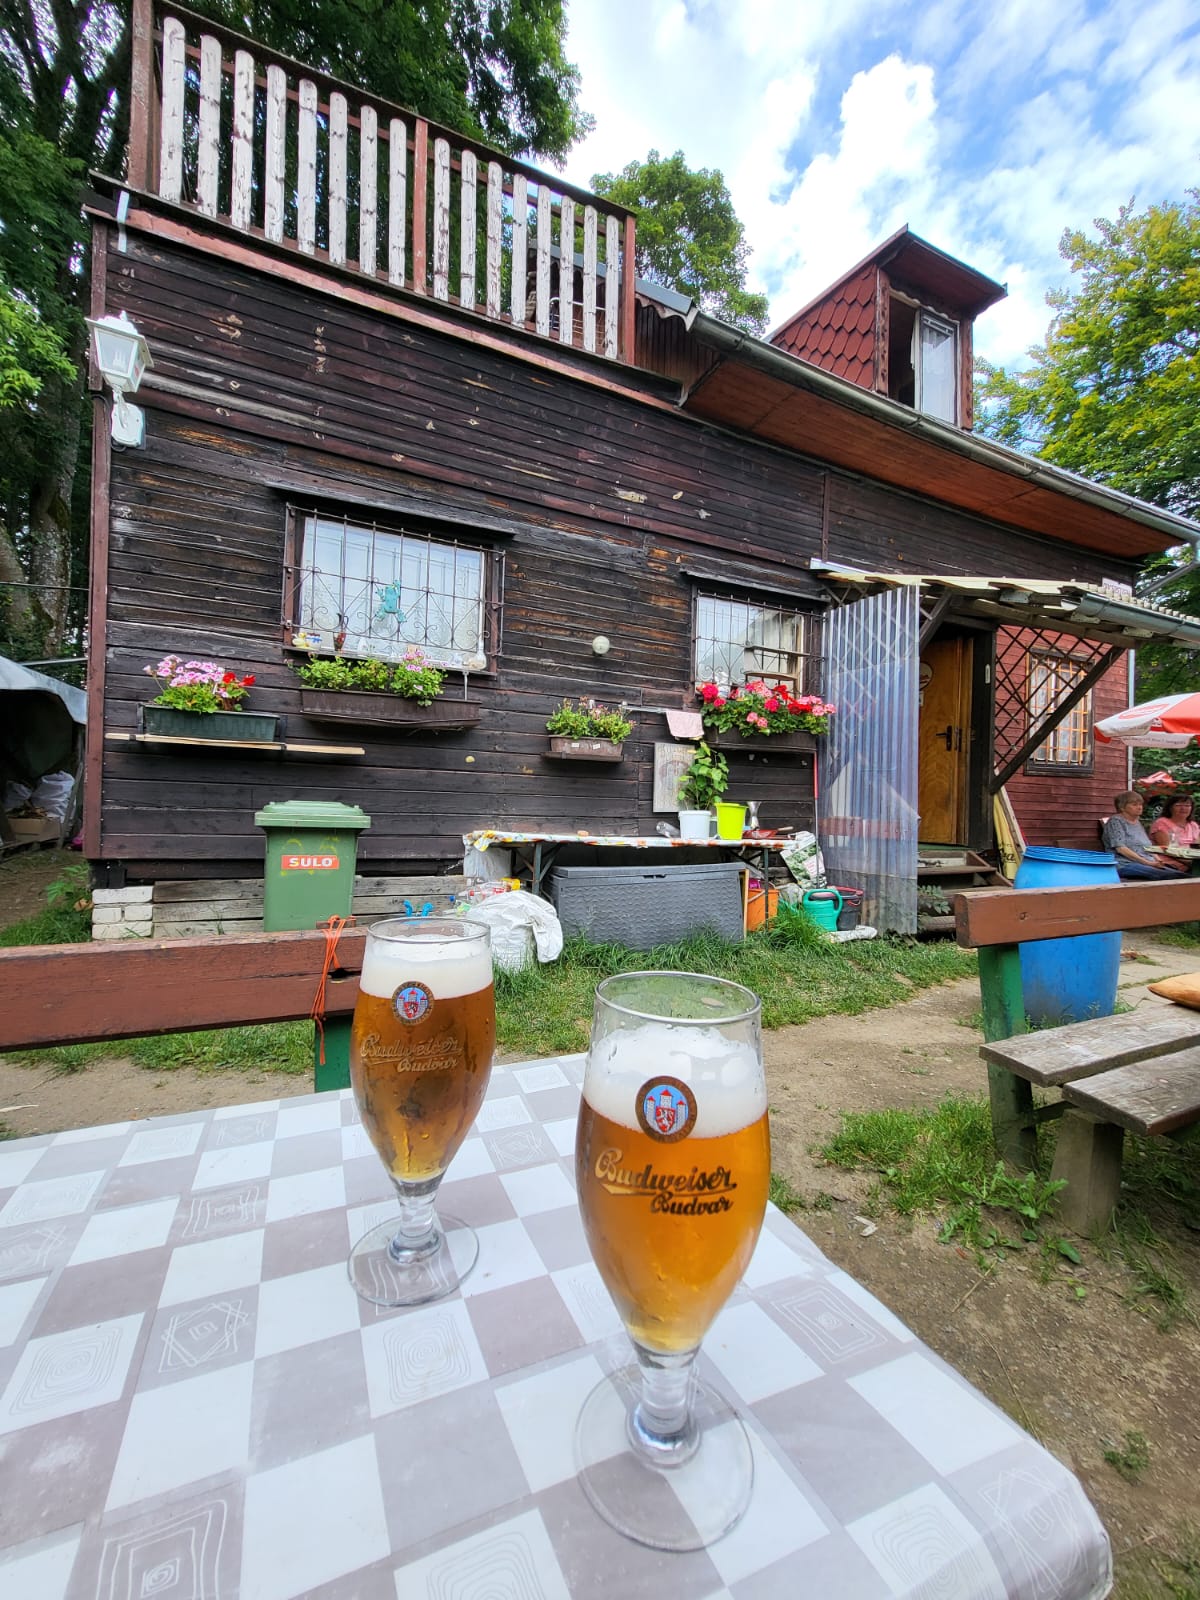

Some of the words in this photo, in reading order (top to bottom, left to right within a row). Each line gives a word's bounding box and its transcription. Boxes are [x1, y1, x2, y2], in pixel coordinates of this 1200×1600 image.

[289, 857, 333, 867] SULO
[360, 1032, 464, 1058] Budweiser
[397, 1055, 457, 1073] Budvar
[594, 1149, 737, 1192] Budweiser
[650, 1191, 733, 1216] Budvar
